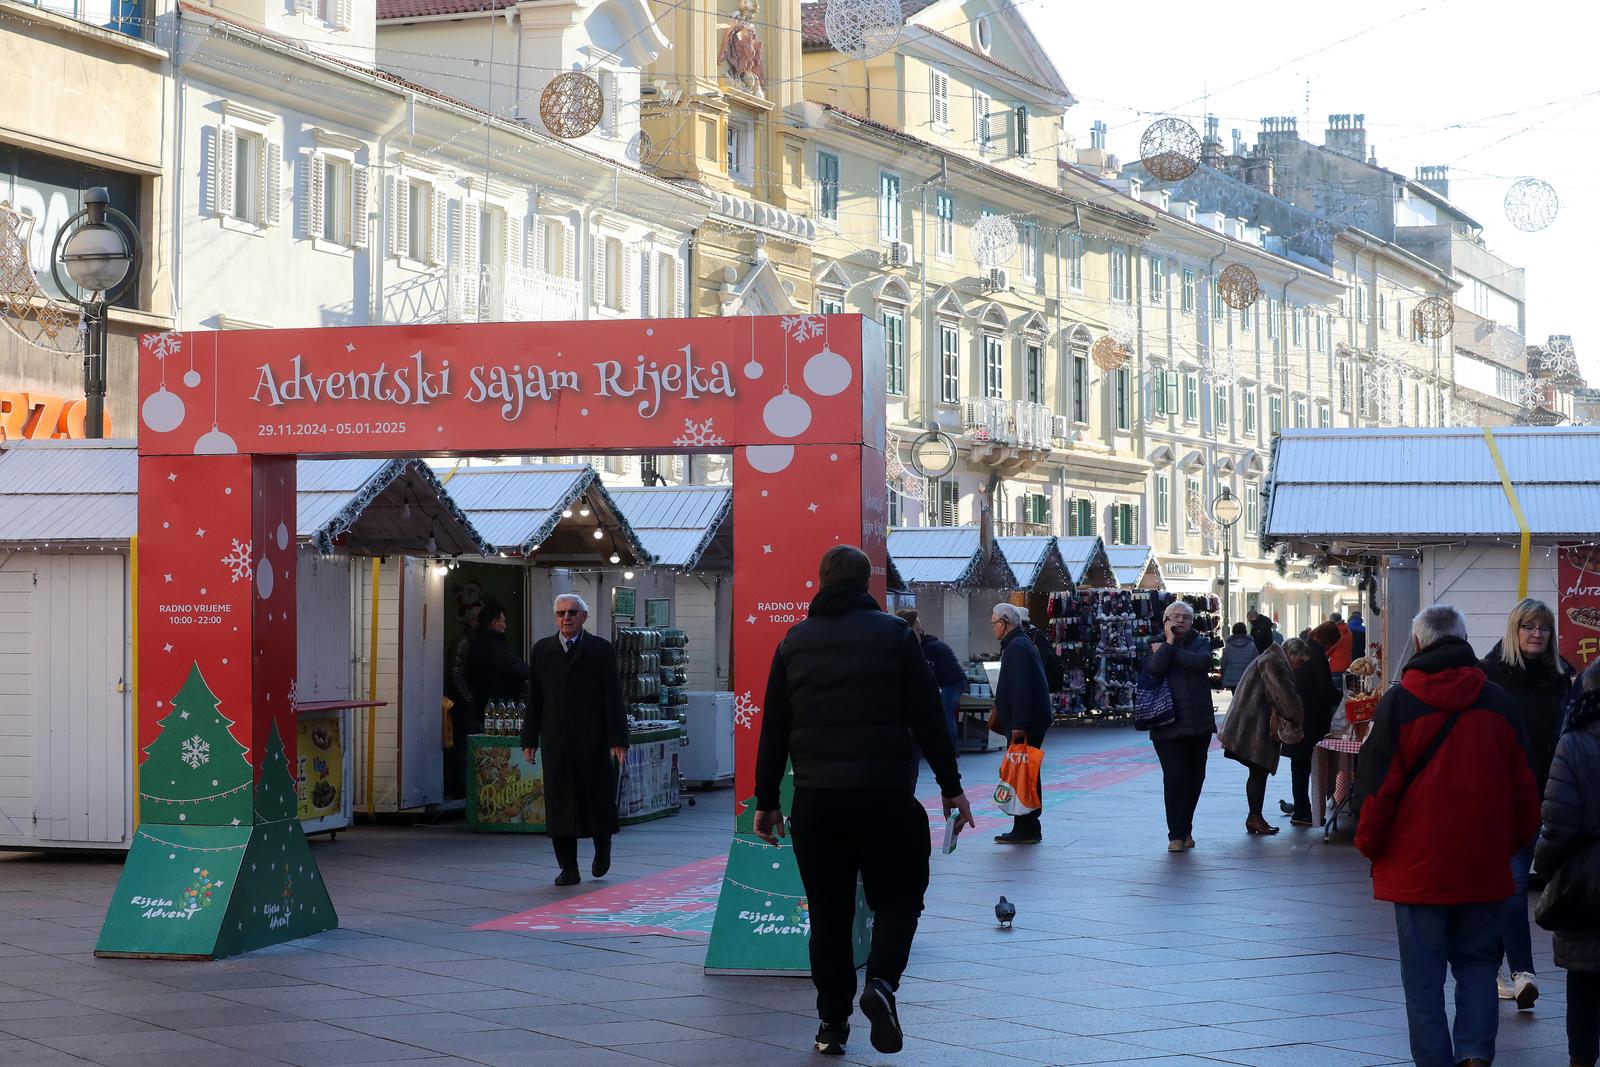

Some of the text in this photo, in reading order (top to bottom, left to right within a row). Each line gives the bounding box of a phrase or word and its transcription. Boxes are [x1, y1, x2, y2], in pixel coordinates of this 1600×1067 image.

[249, 343, 736, 421] Adventski sajam Rijeka
[258, 423, 327, 436] 29.11.2024
[336, 422, 406, 434] 05.01.2025
[159, 604, 232, 613] RADNO VRIJEME
[757, 602, 794, 611] RADNO
[169, 616, 192, 624] 10:00
[198, 616, 222, 624] 22:00
[768, 614, 794, 623] 10:00
[1007, 751, 1029, 764] KTC
[131, 896, 174, 908] Rijeka
[738, 910, 785, 924] Rijeka
